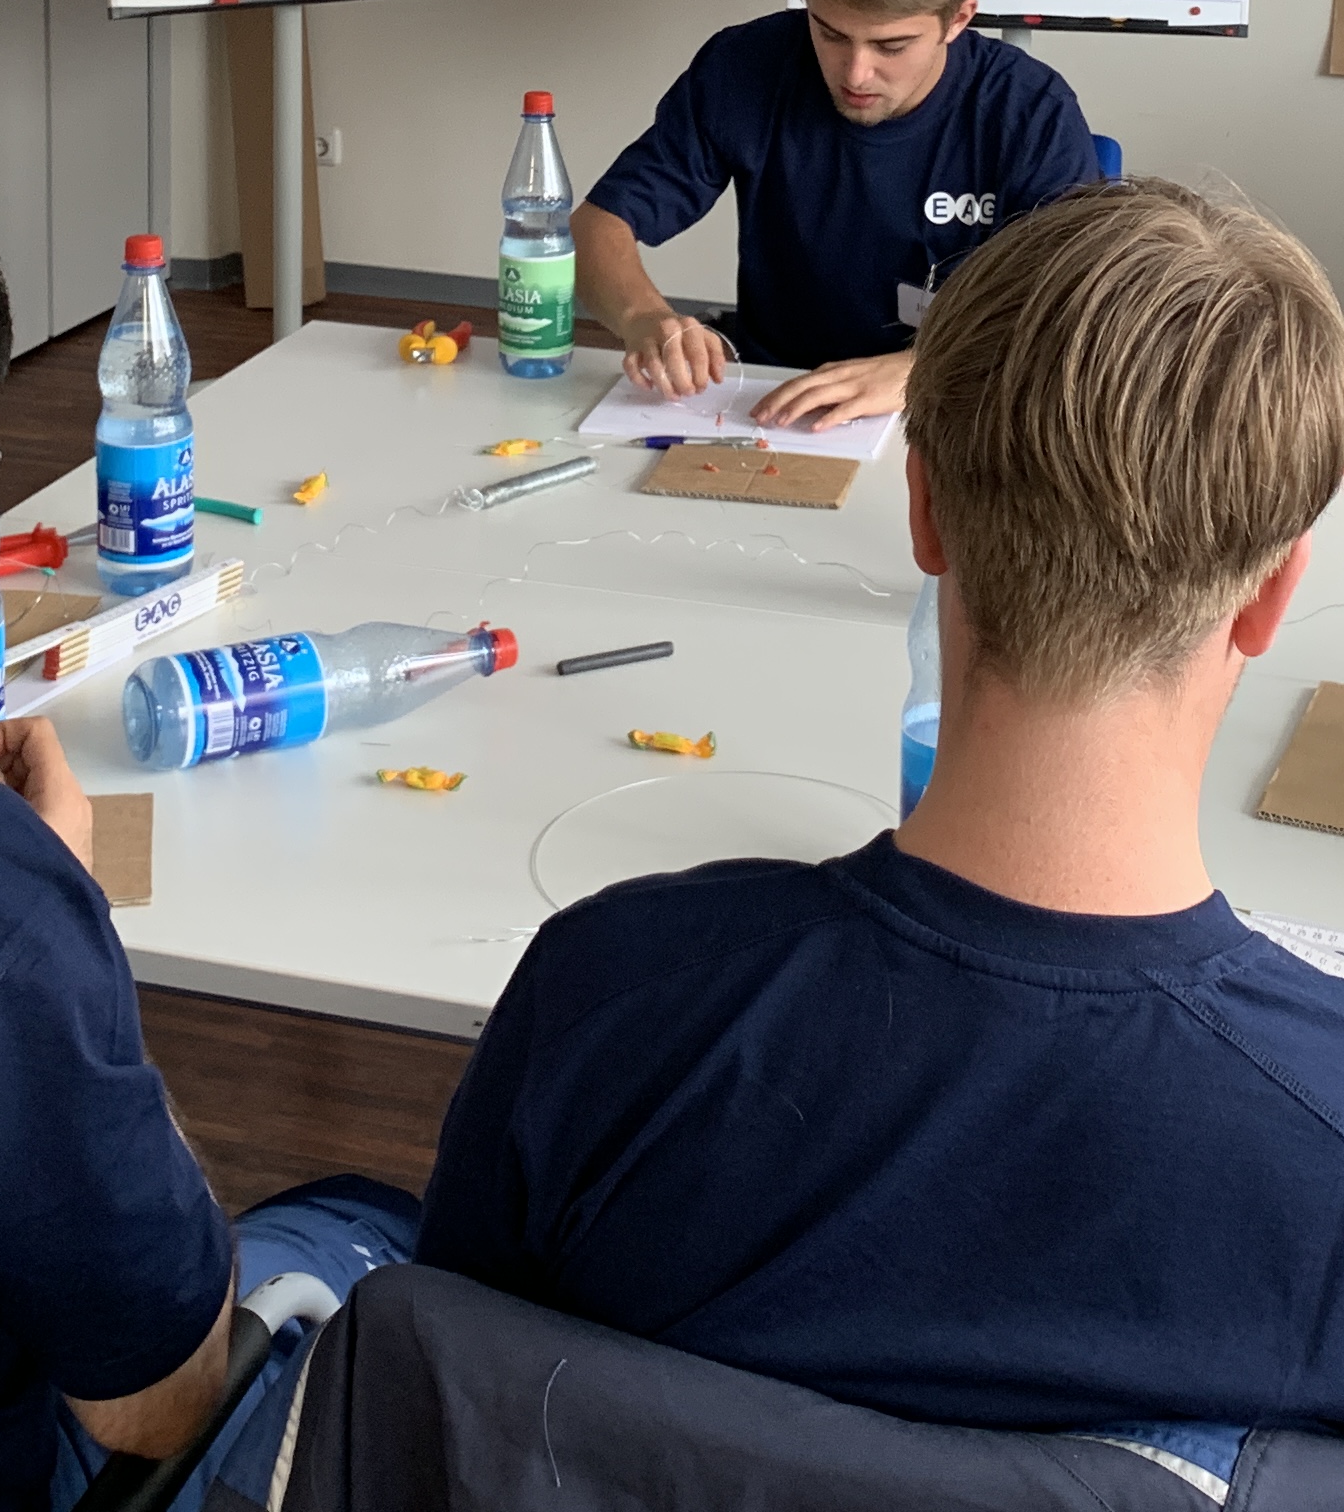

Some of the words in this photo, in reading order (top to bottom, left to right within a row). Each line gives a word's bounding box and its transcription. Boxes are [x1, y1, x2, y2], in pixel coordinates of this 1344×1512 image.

[925, 192, 996, 225] EAG
[504, 288, 542, 304] ASIA
[163, 493, 193, 510] SPRIT
[135, 592, 182, 632] EAG
[250, 642, 284, 692] ASIA
